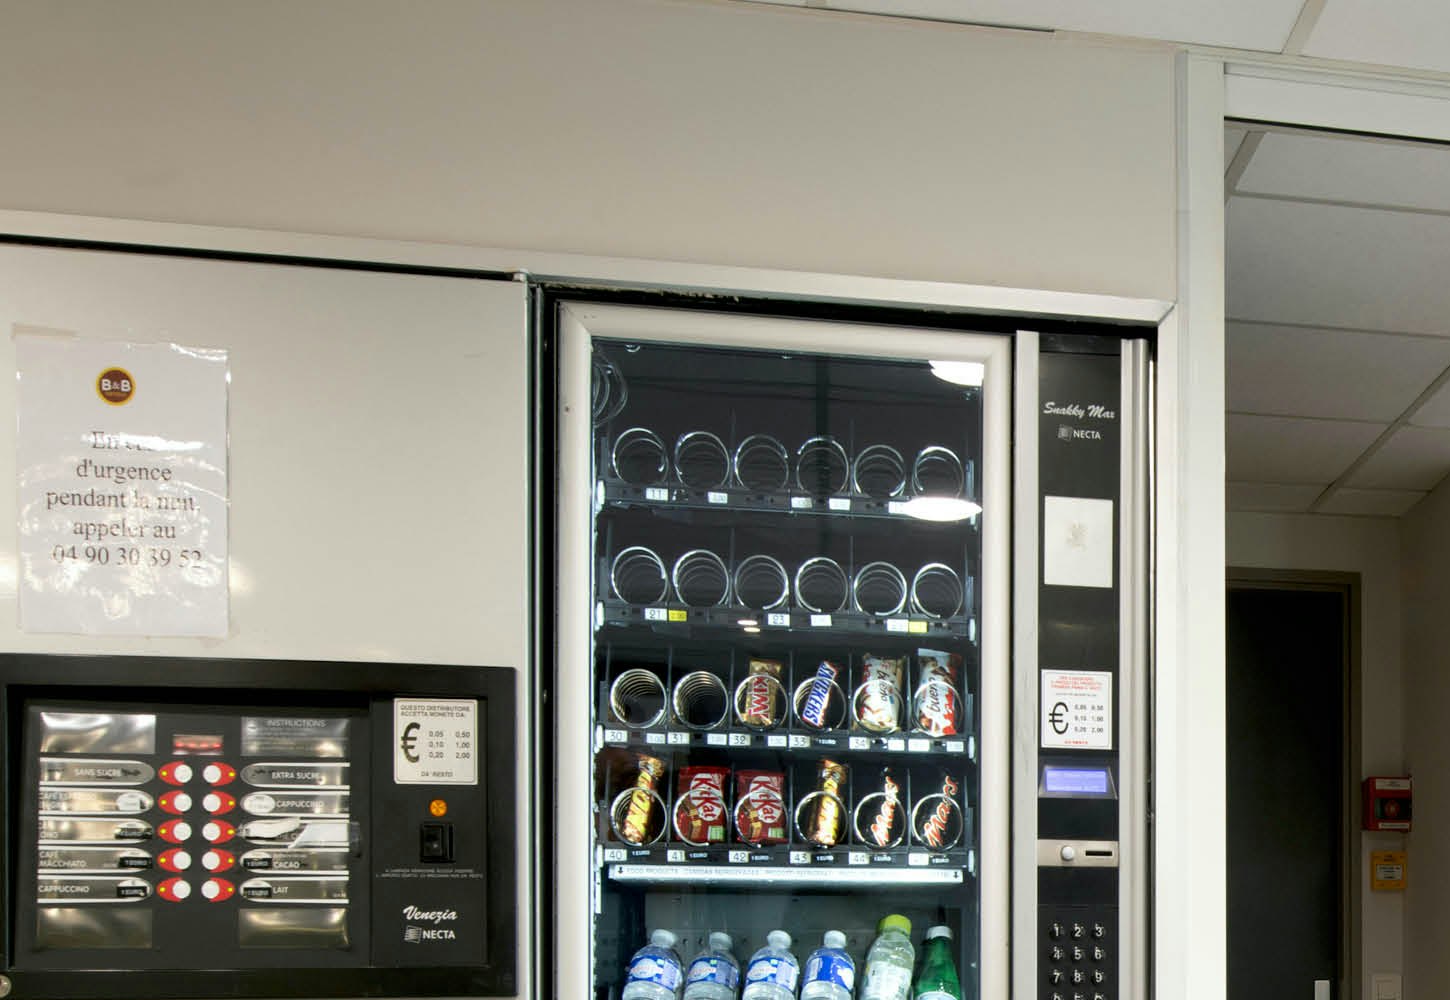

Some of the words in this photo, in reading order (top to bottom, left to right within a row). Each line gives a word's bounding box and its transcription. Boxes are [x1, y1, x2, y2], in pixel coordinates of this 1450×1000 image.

[101, 379, 131, 392] B&B
[1043, 401, 1085, 419] Snakky
[1073, 429, 1101, 440] NECTA
[76, 459, 172, 484] d'urgence
[46, 489, 126, 510] pendant
[134, 490, 150, 508] la
[73, 518, 145, 540] appeler
[153, 524, 176, 539] au
[53, 545, 78, 563] 04
[85, 546, 109, 565] 90
[117, 547, 140, 565] 30
[609, 731, 623, 741] 30
[733, 734, 746, 745] 32
[271, 771, 294, 780] EXTRA
[276, 800, 325, 808] CAPPUCCINO
[39, 860, 87, 869] MACCHIATO
[273, 861, 300, 869] CACAO
[39, 885, 90, 893] CAPPUCCINO
[272, 886, 289, 894] LAIT
[403, 905, 458, 925] Venezia
[422, 930, 456, 939] NECTA
